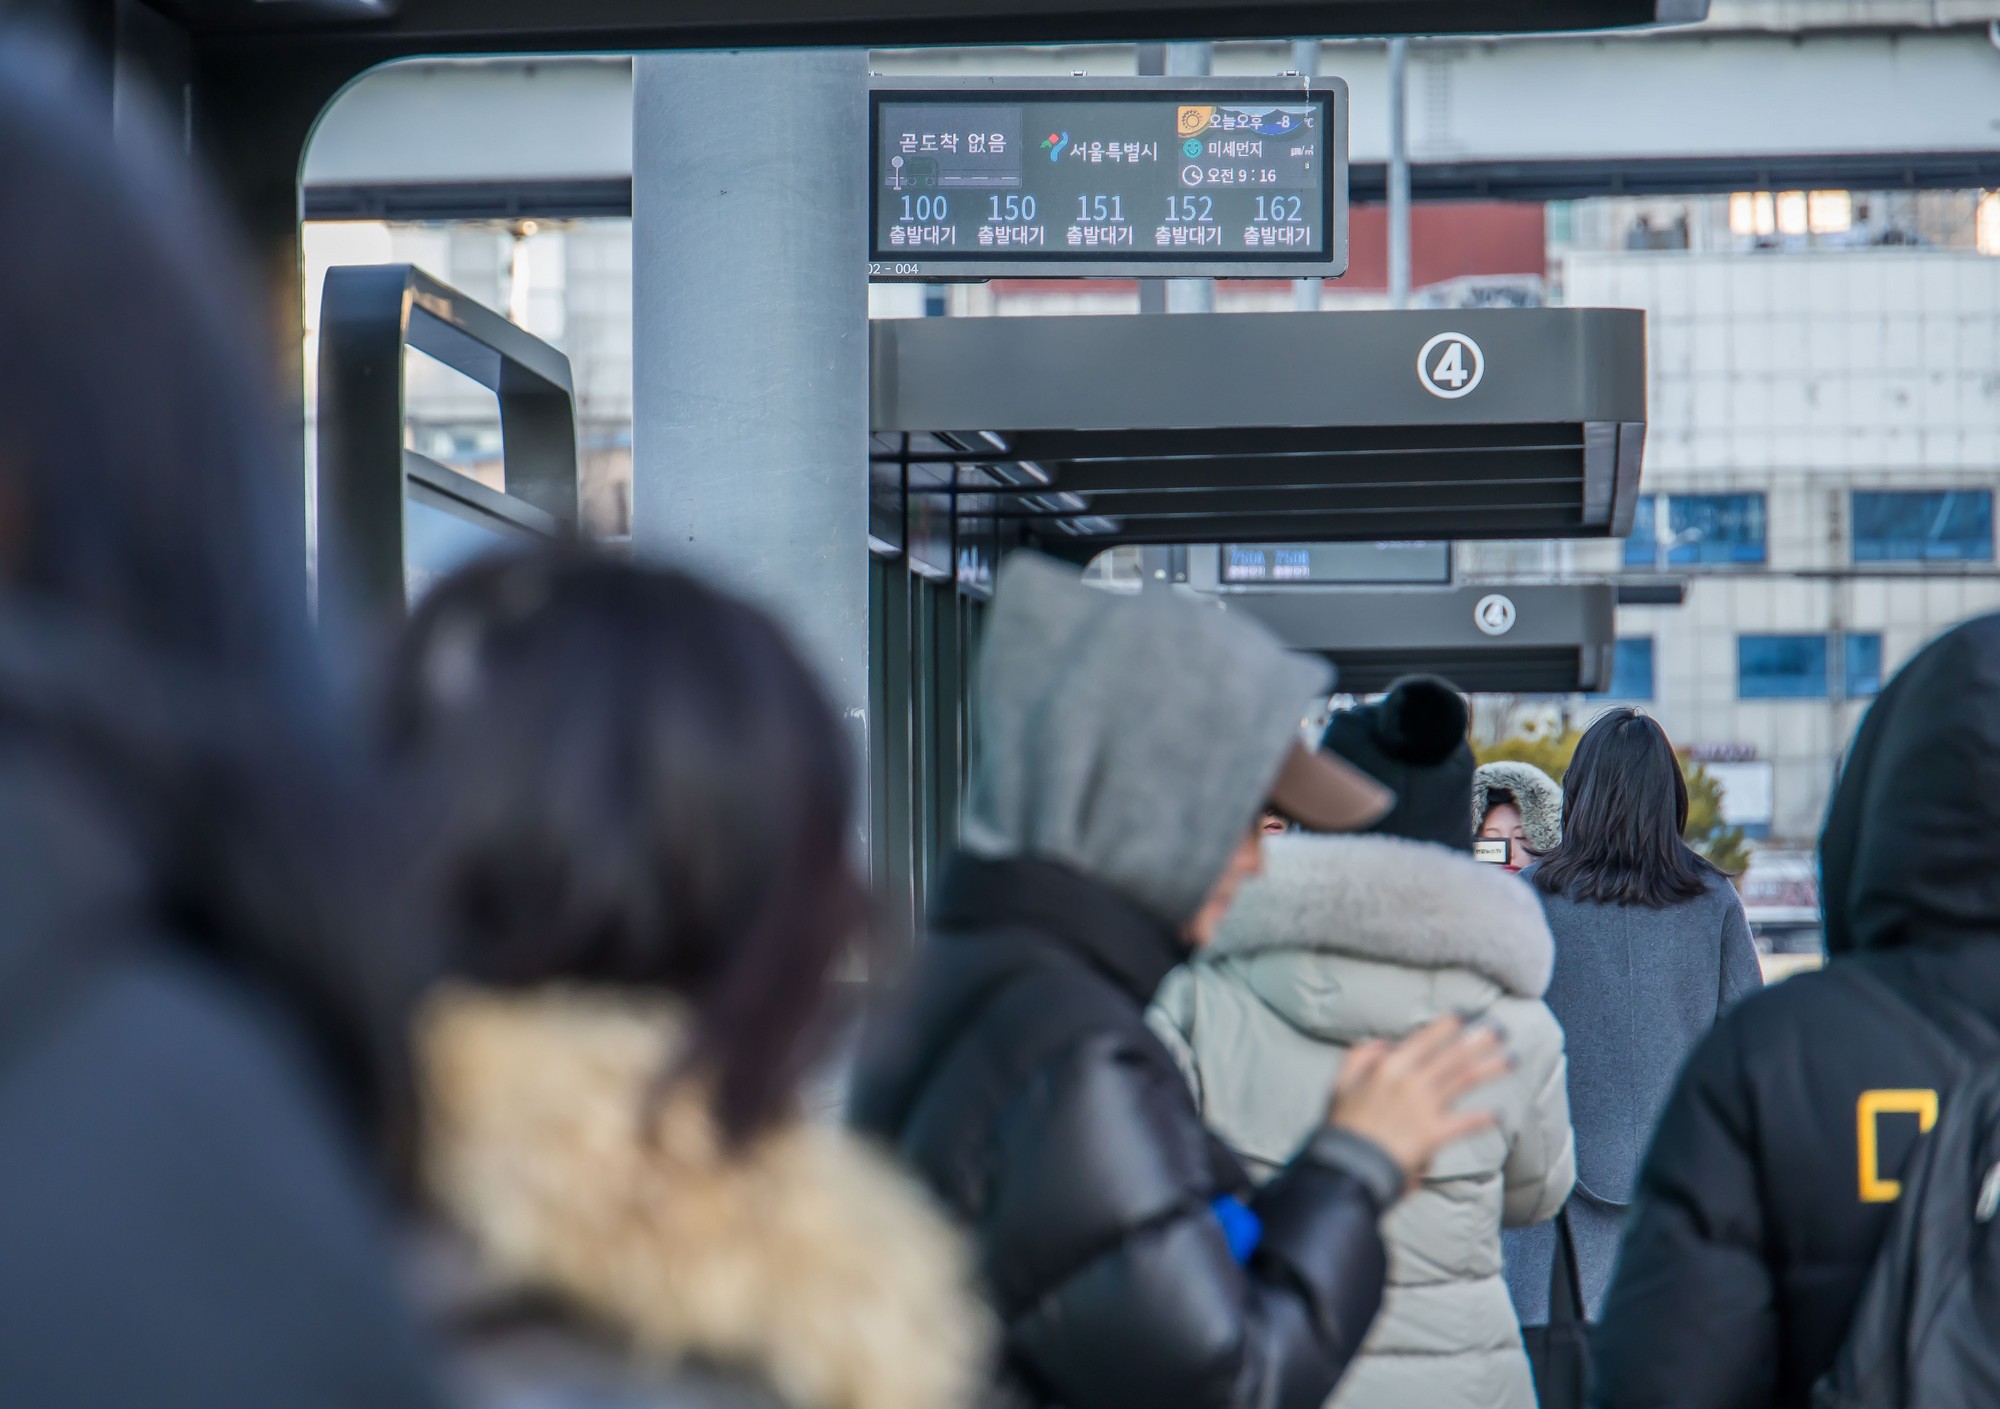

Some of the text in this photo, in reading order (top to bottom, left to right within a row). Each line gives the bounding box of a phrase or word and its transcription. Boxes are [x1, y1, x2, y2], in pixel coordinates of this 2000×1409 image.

[1209, 114, 1263, 130] 오늘오후
[1276, 115, 1290, 128] -8
[899, 133, 1006, 153] 곧도착 없음
[1070, 141, 1158, 162] 서울특별시
[1208, 141, 1262, 157] 미세먼지
[1206, 168, 1234, 183] 오전
[899, 195, 948, 221] 100
[987, 195, 1036, 221] 150
[1076, 195, 1124, 221] 151
[1165, 195, 1213, 221] 152
[1253, 195, 1302, 221] 162
[889, 225, 956, 245] 출발대기
[977, 225, 1044, 245] 출발대기
[1066, 225, 1133, 245] 출발대기
[1155, 225, 1222, 245] 출발대기
[1243, 225, 1310, 245] 출발대기
[895, 263, 919, 274] 004
